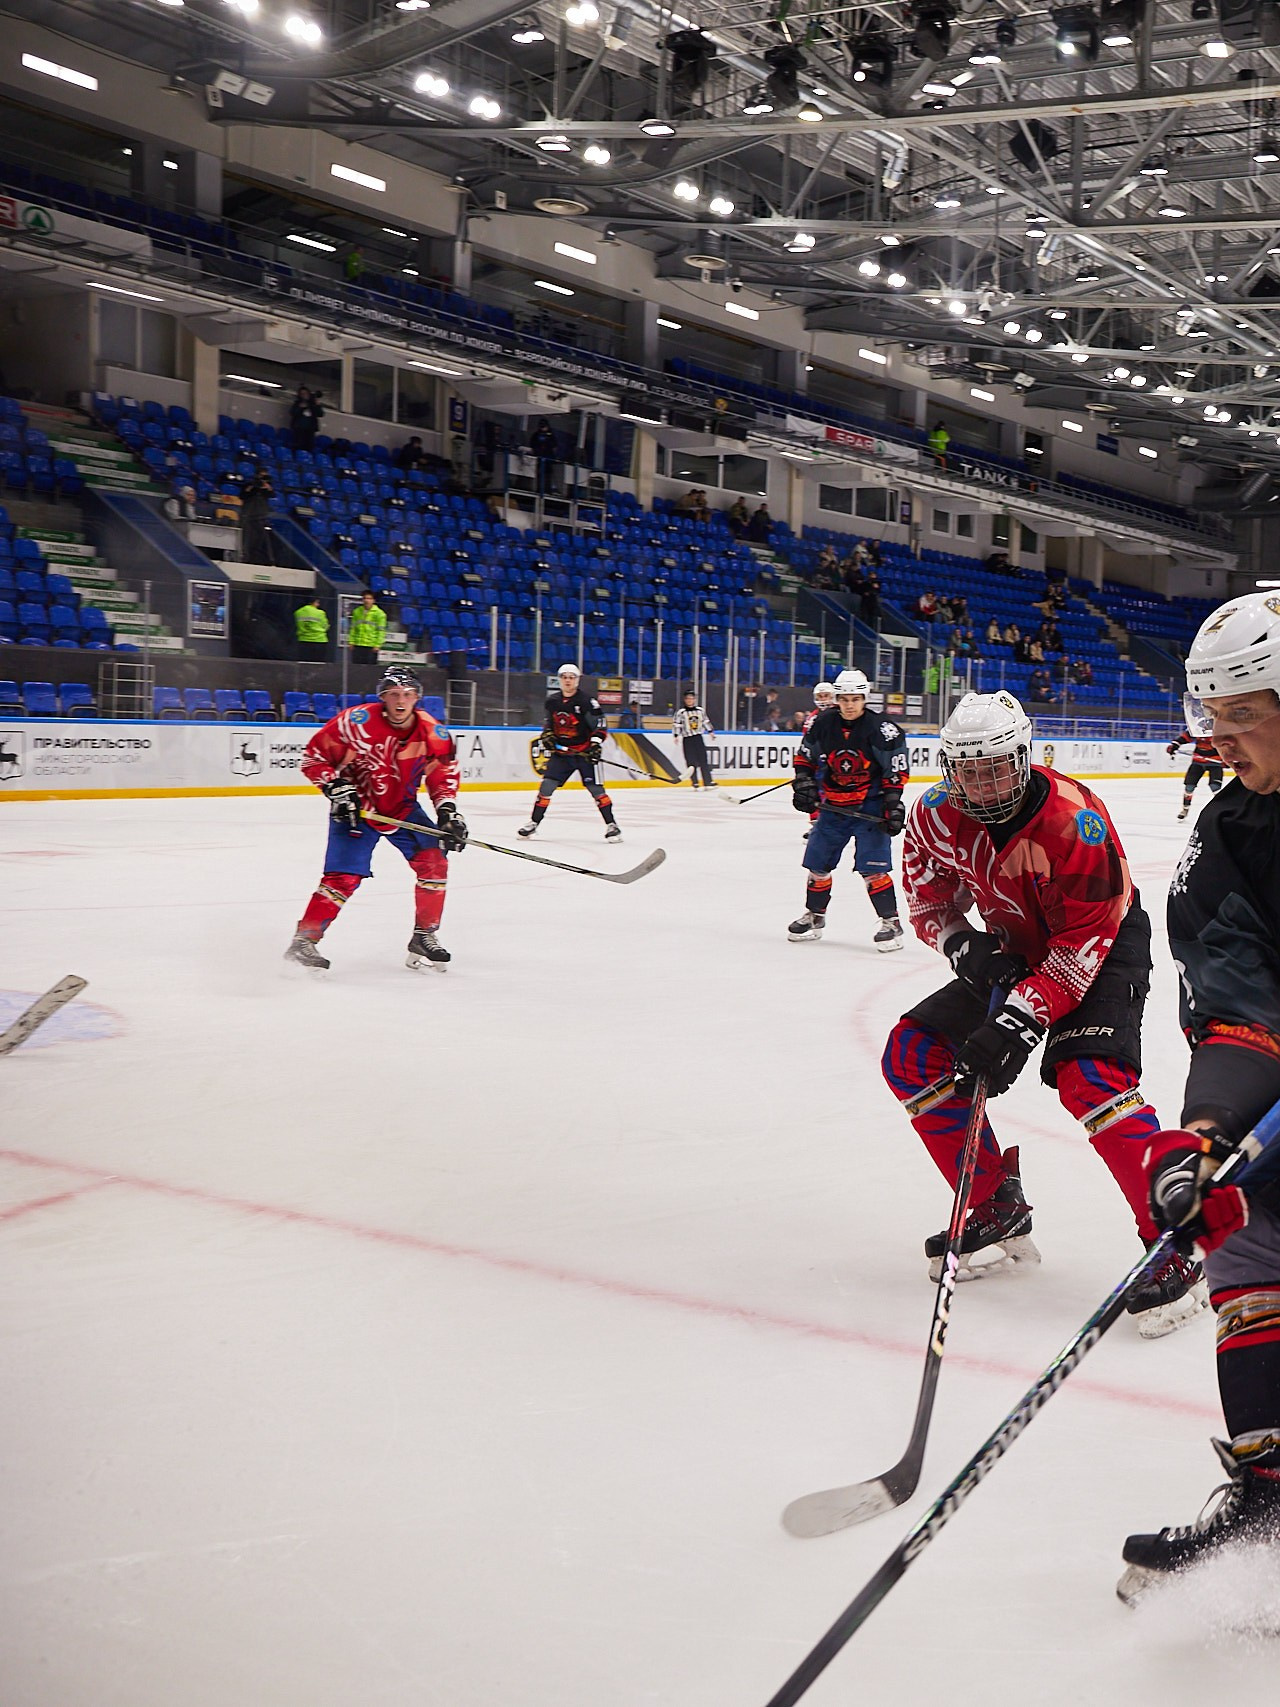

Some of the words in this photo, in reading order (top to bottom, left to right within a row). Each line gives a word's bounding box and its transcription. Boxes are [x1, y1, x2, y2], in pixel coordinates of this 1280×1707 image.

[1190, 667, 1214, 675] BAUER
[33, 737, 152, 750] ПРАВИТЕЛЬСТВО
[269, 743, 307, 754] НИЖН
[955, 739, 983, 747] BAUER
[34, 752, 142, 765] НИЖЕГОРОДСКОЙ
[269, 758, 303, 769] НОВГ
[704, 746, 797, 769] ФИЦЕРС
[891, 753, 907, 773] 93
[33, 766, 91, 777] ОБЛАСТИ
[995, 1011, 1041, 1048] CC
[1049, 1026, 1116, 1049] BAUER
